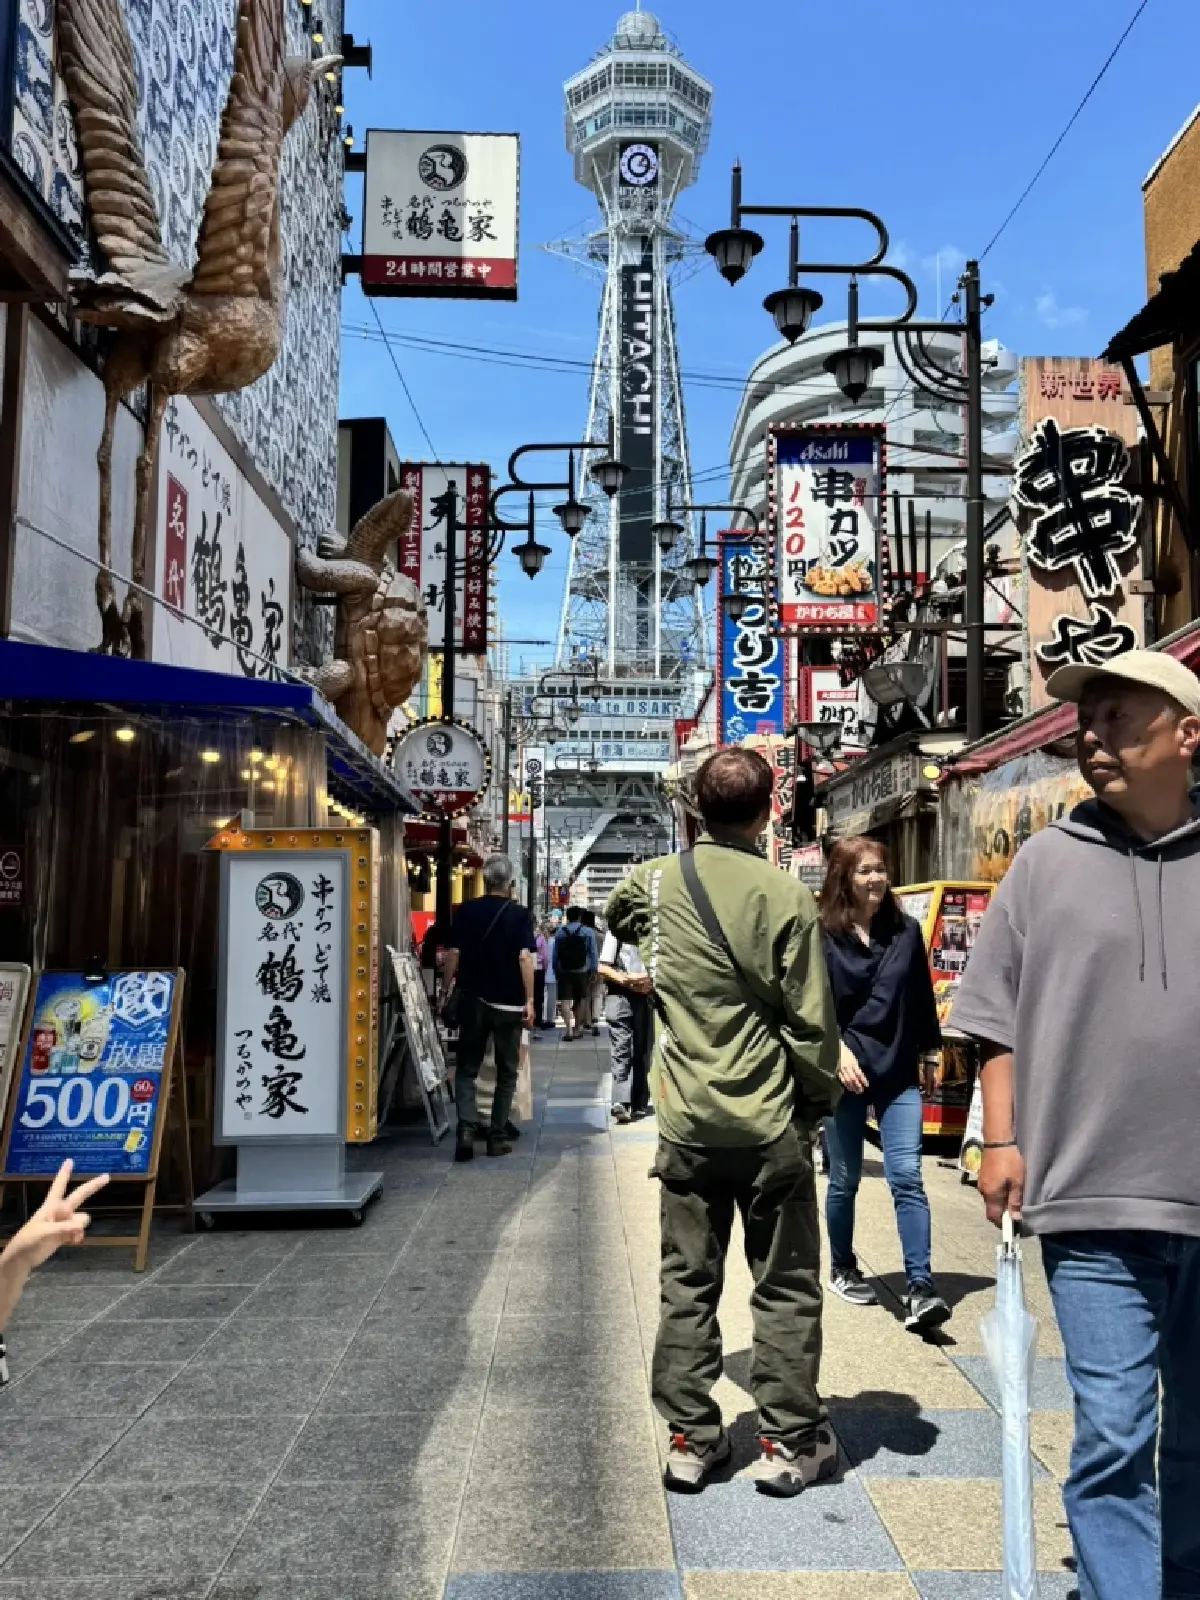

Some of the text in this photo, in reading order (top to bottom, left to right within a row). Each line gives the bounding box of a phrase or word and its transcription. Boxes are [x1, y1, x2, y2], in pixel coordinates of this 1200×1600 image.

[405, 208, 498, 242] 鶴亀家
[386, 260, 492, 278] 24時間営業中
[627, 272, 652, 434] HITACHI
[1041, 371, 1122, 399] 新世界
[800, 441, 849, 460] Asahi
[811, 467, 859, 567] 串カツ
[257, 921, 303, 941] 名代
[310, 873, 335, 1002] 串かつ どて焼
[255, 943, 309, 1119] 鶴亀家
